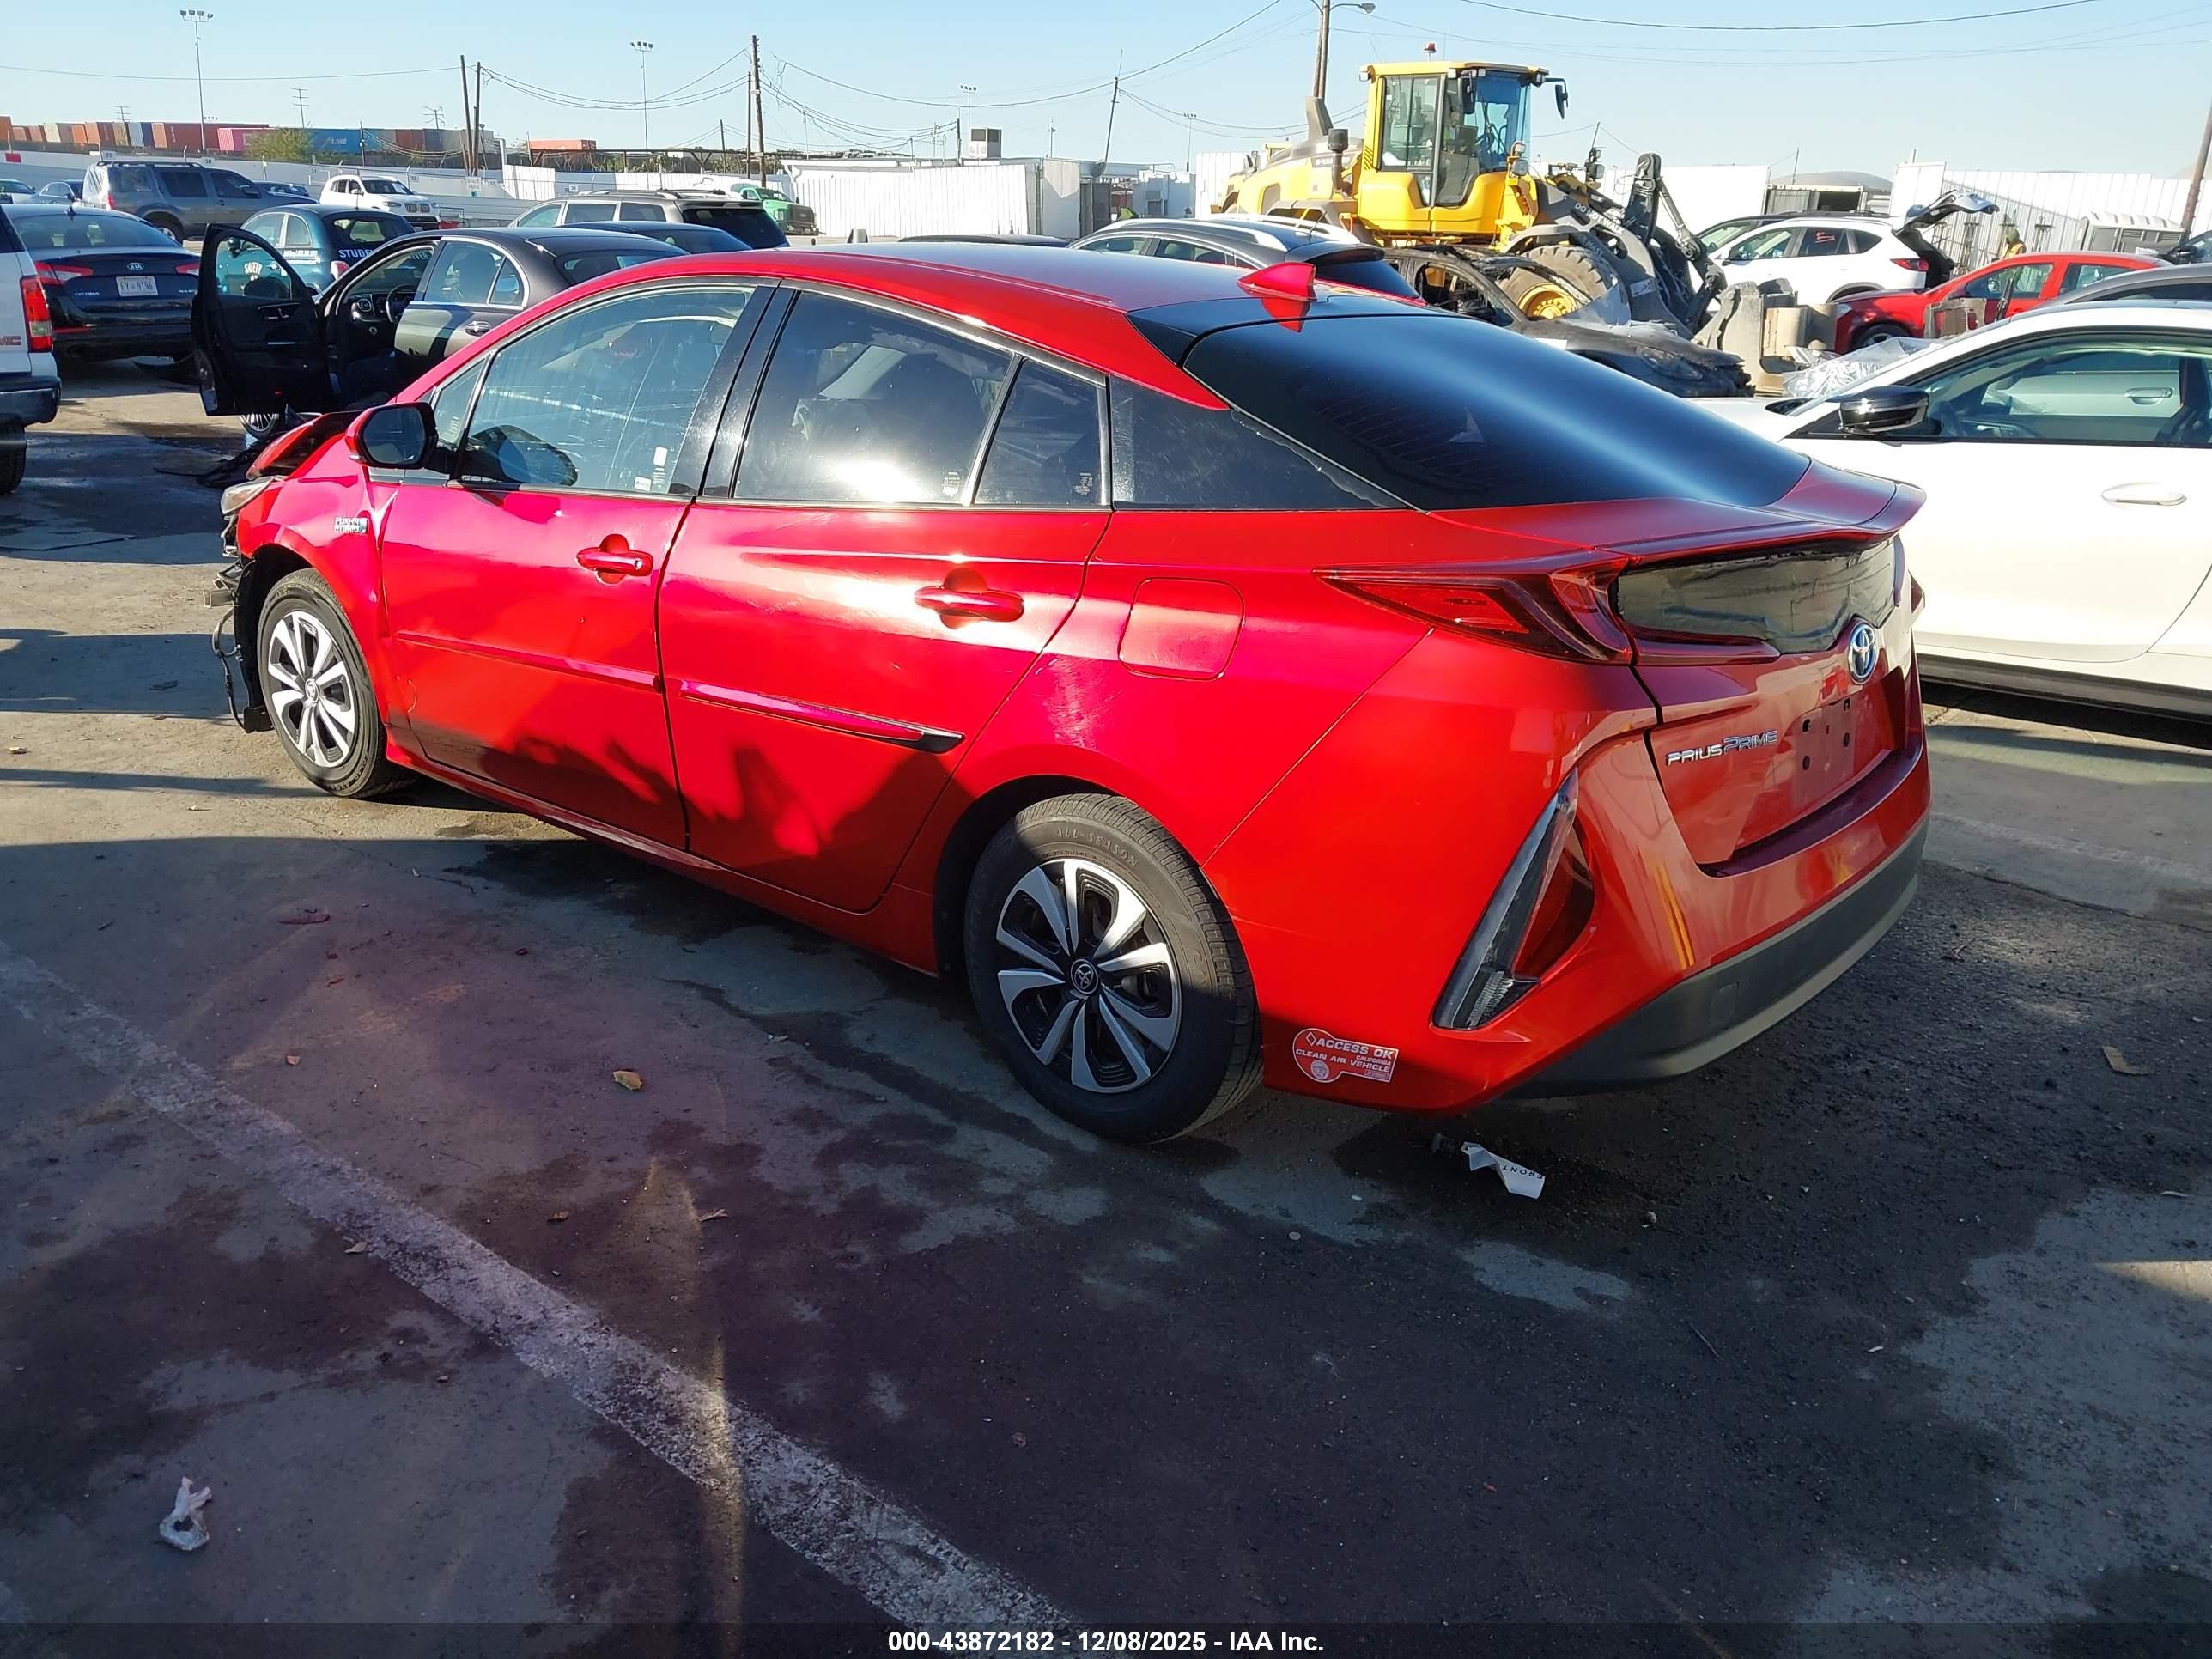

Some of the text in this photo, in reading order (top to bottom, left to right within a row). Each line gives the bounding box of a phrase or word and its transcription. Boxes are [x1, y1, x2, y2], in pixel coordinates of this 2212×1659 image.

[1316, 156, 1351, 166] VOLO
[1575, 203, 1587, 213] DO
[1667, 730, 1778, 766] PRIUS PRIME
[1055, 826, 1140, 869] ALL-SEASON
[1295, 1048, 1391, 1072] CLEAN AIR VEHICLE
[1316, 1037, 1395, 1060] ACCESS OK
[1356, 1054, 1392, 1066] CALIFORNIA
